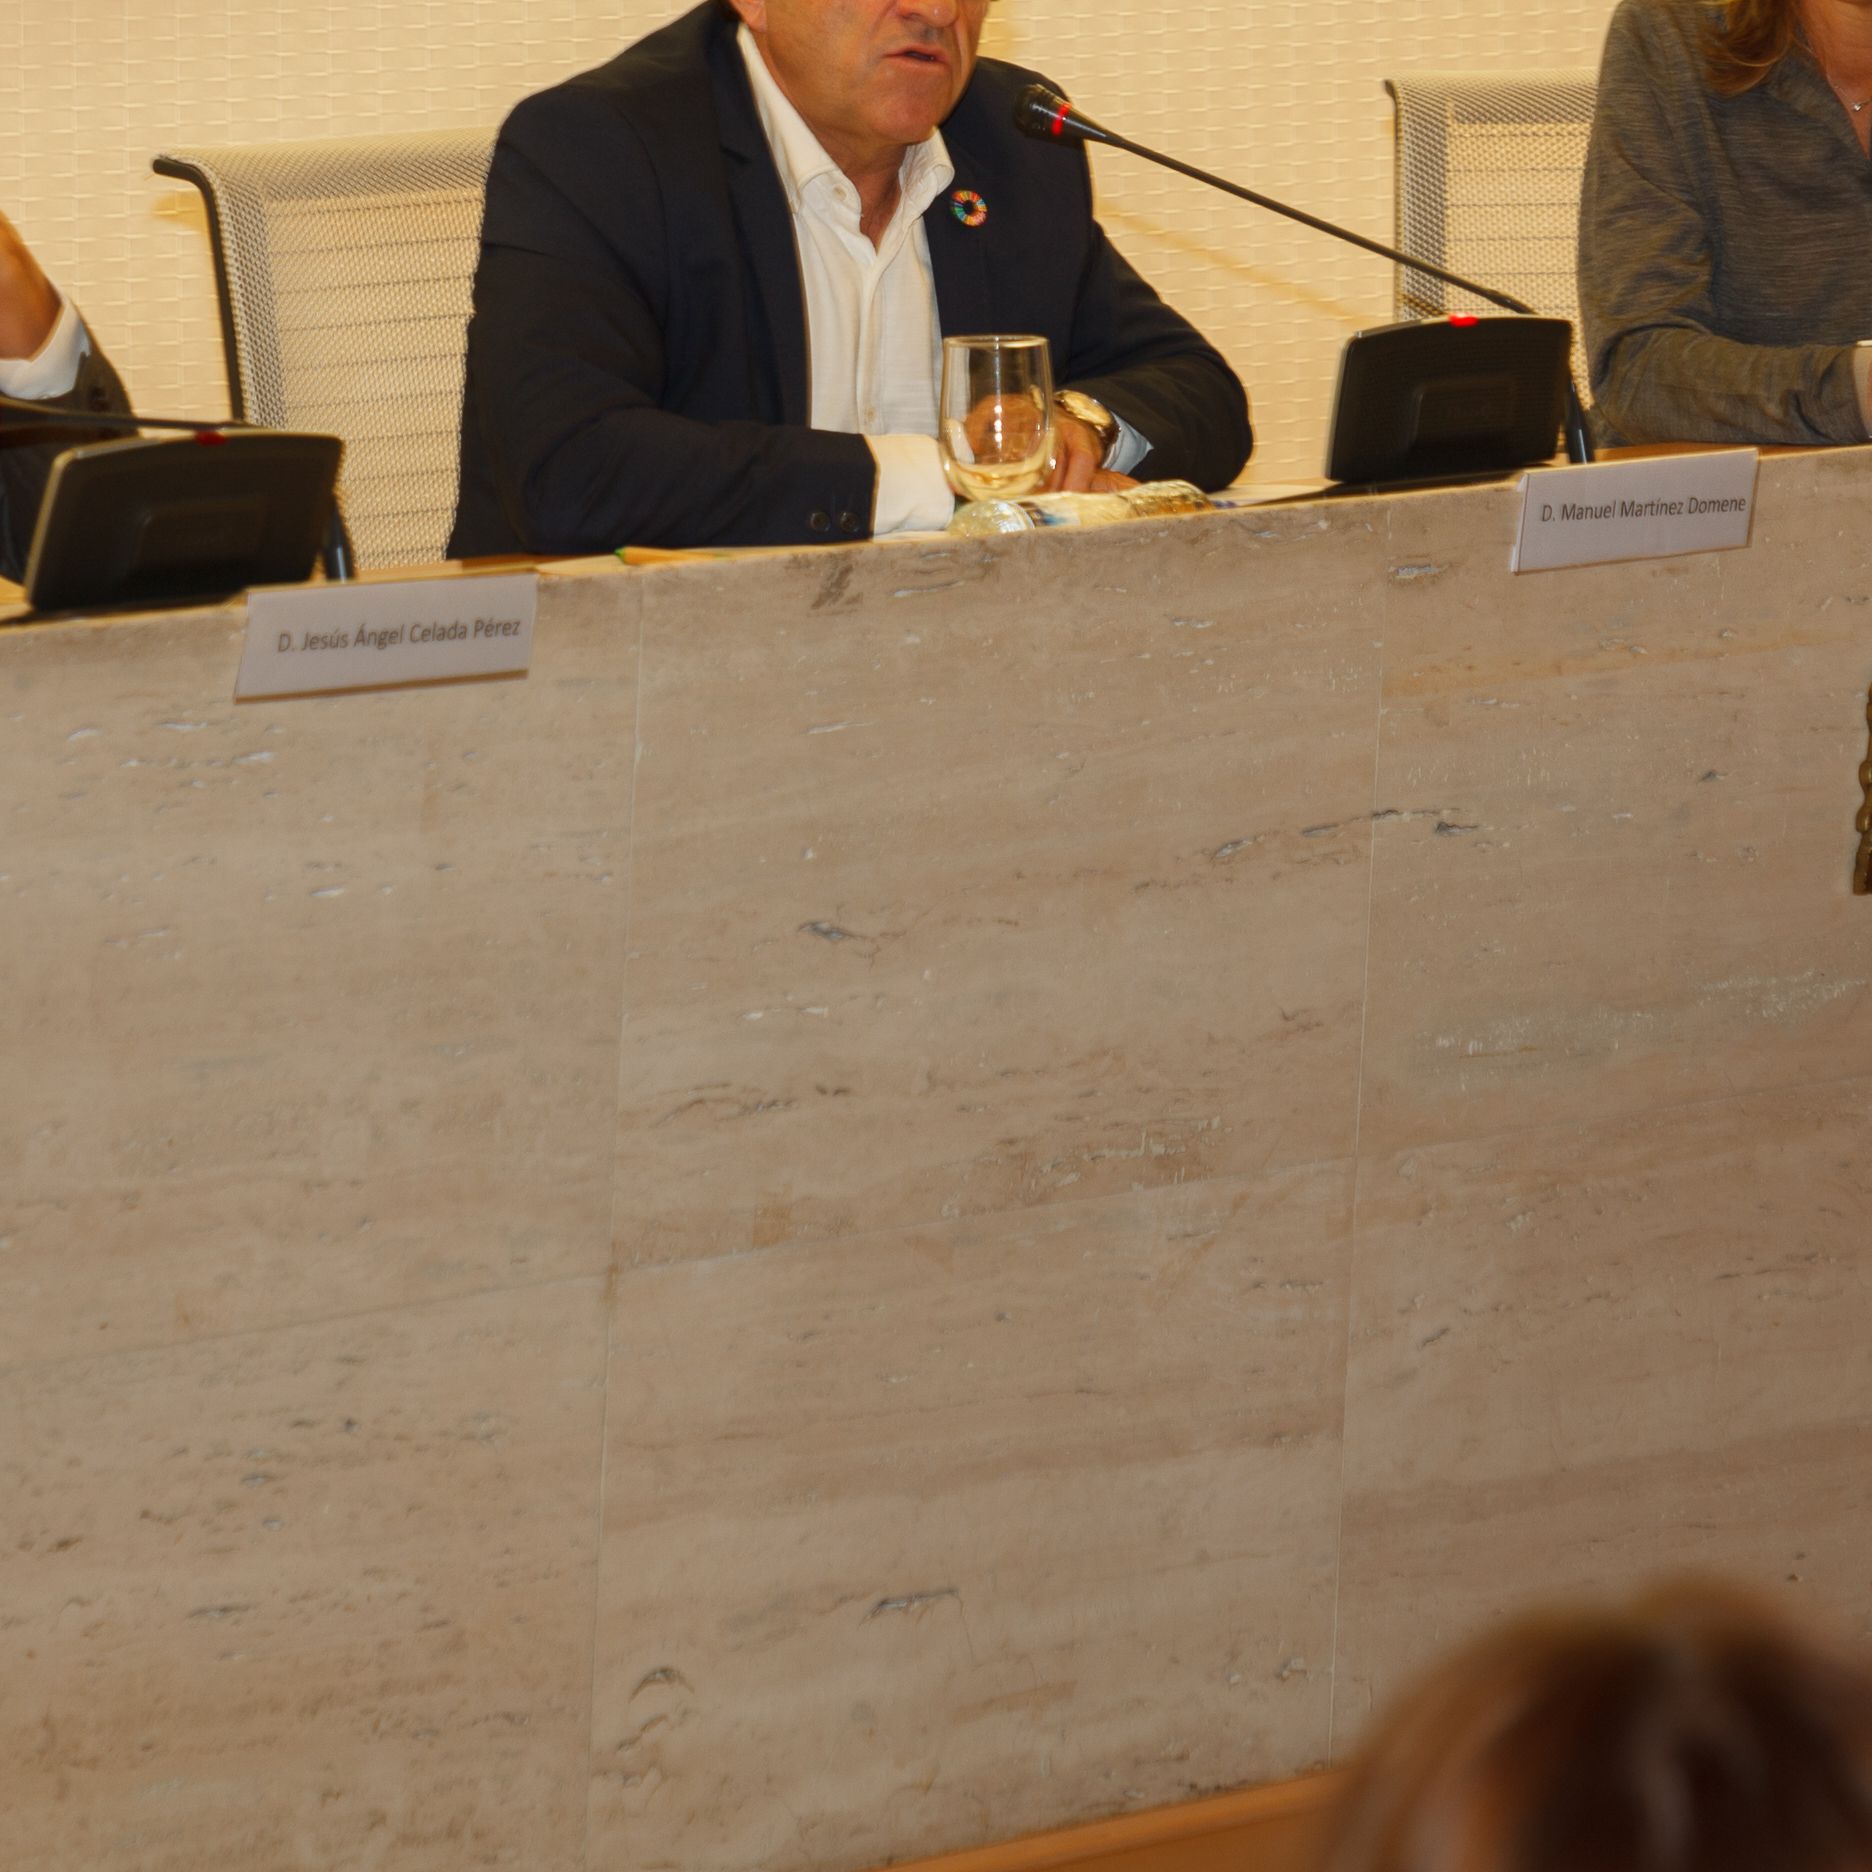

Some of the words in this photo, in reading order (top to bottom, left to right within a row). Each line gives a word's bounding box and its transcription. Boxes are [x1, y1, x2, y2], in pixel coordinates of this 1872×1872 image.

[1541, 504, 1556, 523] D.
[1560, 500, 1617, 521] Manuel
[1620, 498, 1684, 519] Martínez
[1687, 496, 1747, 515] Domene
[277, 630, 296, 653] D.
[301, 627, 349, 651] Jesús
[353, 623, 404, 651] Ángel
[409, 620, 468, 644] Celada
[473, 617, 522, 640] Pérez
